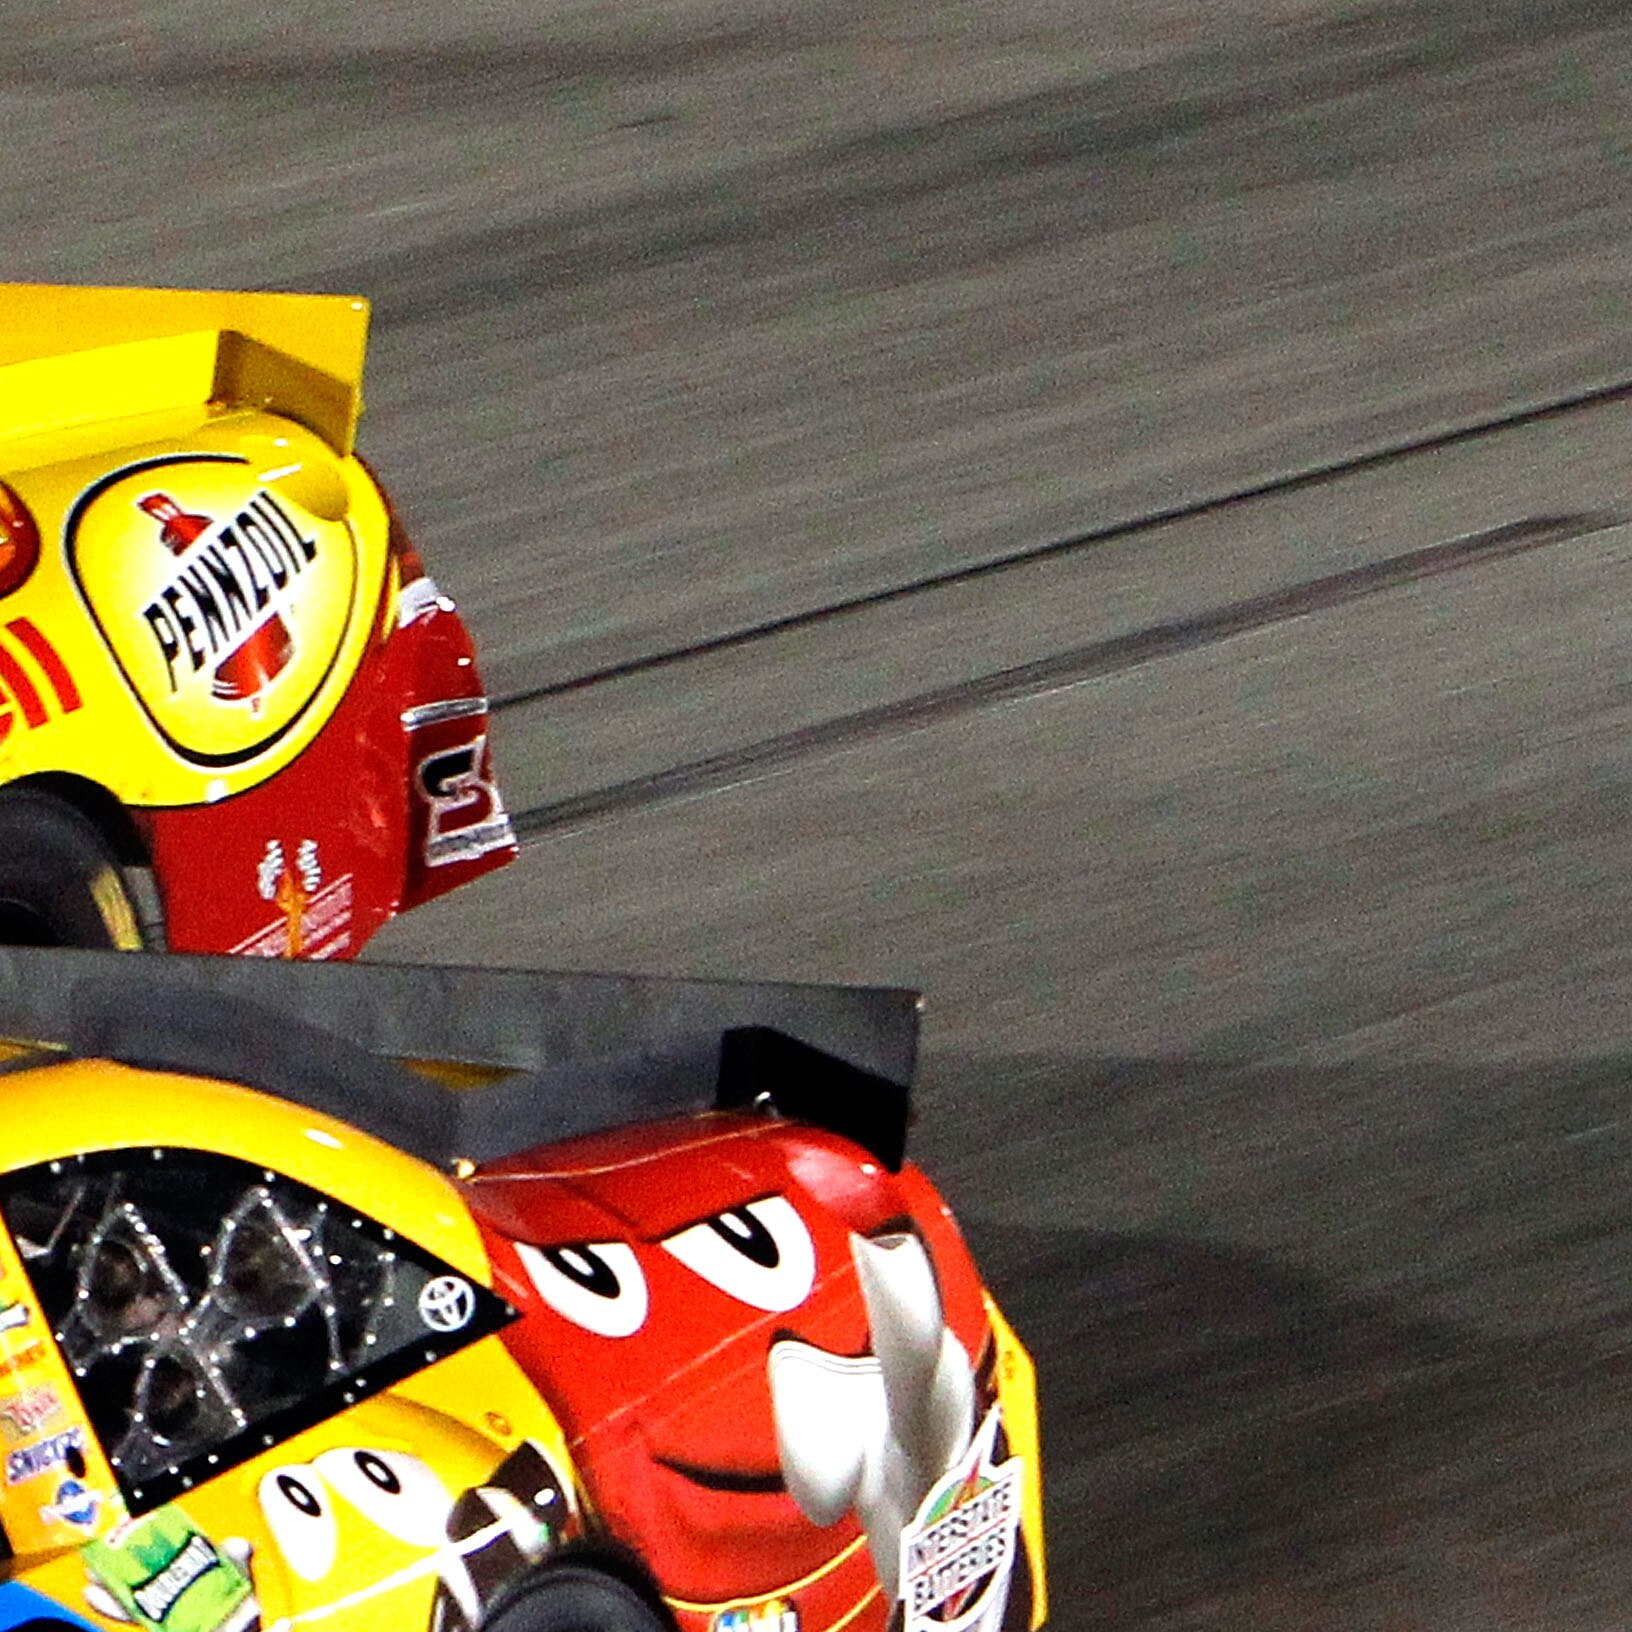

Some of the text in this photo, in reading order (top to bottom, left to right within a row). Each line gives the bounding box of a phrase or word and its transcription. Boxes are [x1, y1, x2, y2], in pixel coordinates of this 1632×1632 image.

[143, 490, 317, 693] PENNZOIL
[907, 1480, 1012, 1572] INTERSTATE
[913, 1526, 1007, 1611] BATTERIES
